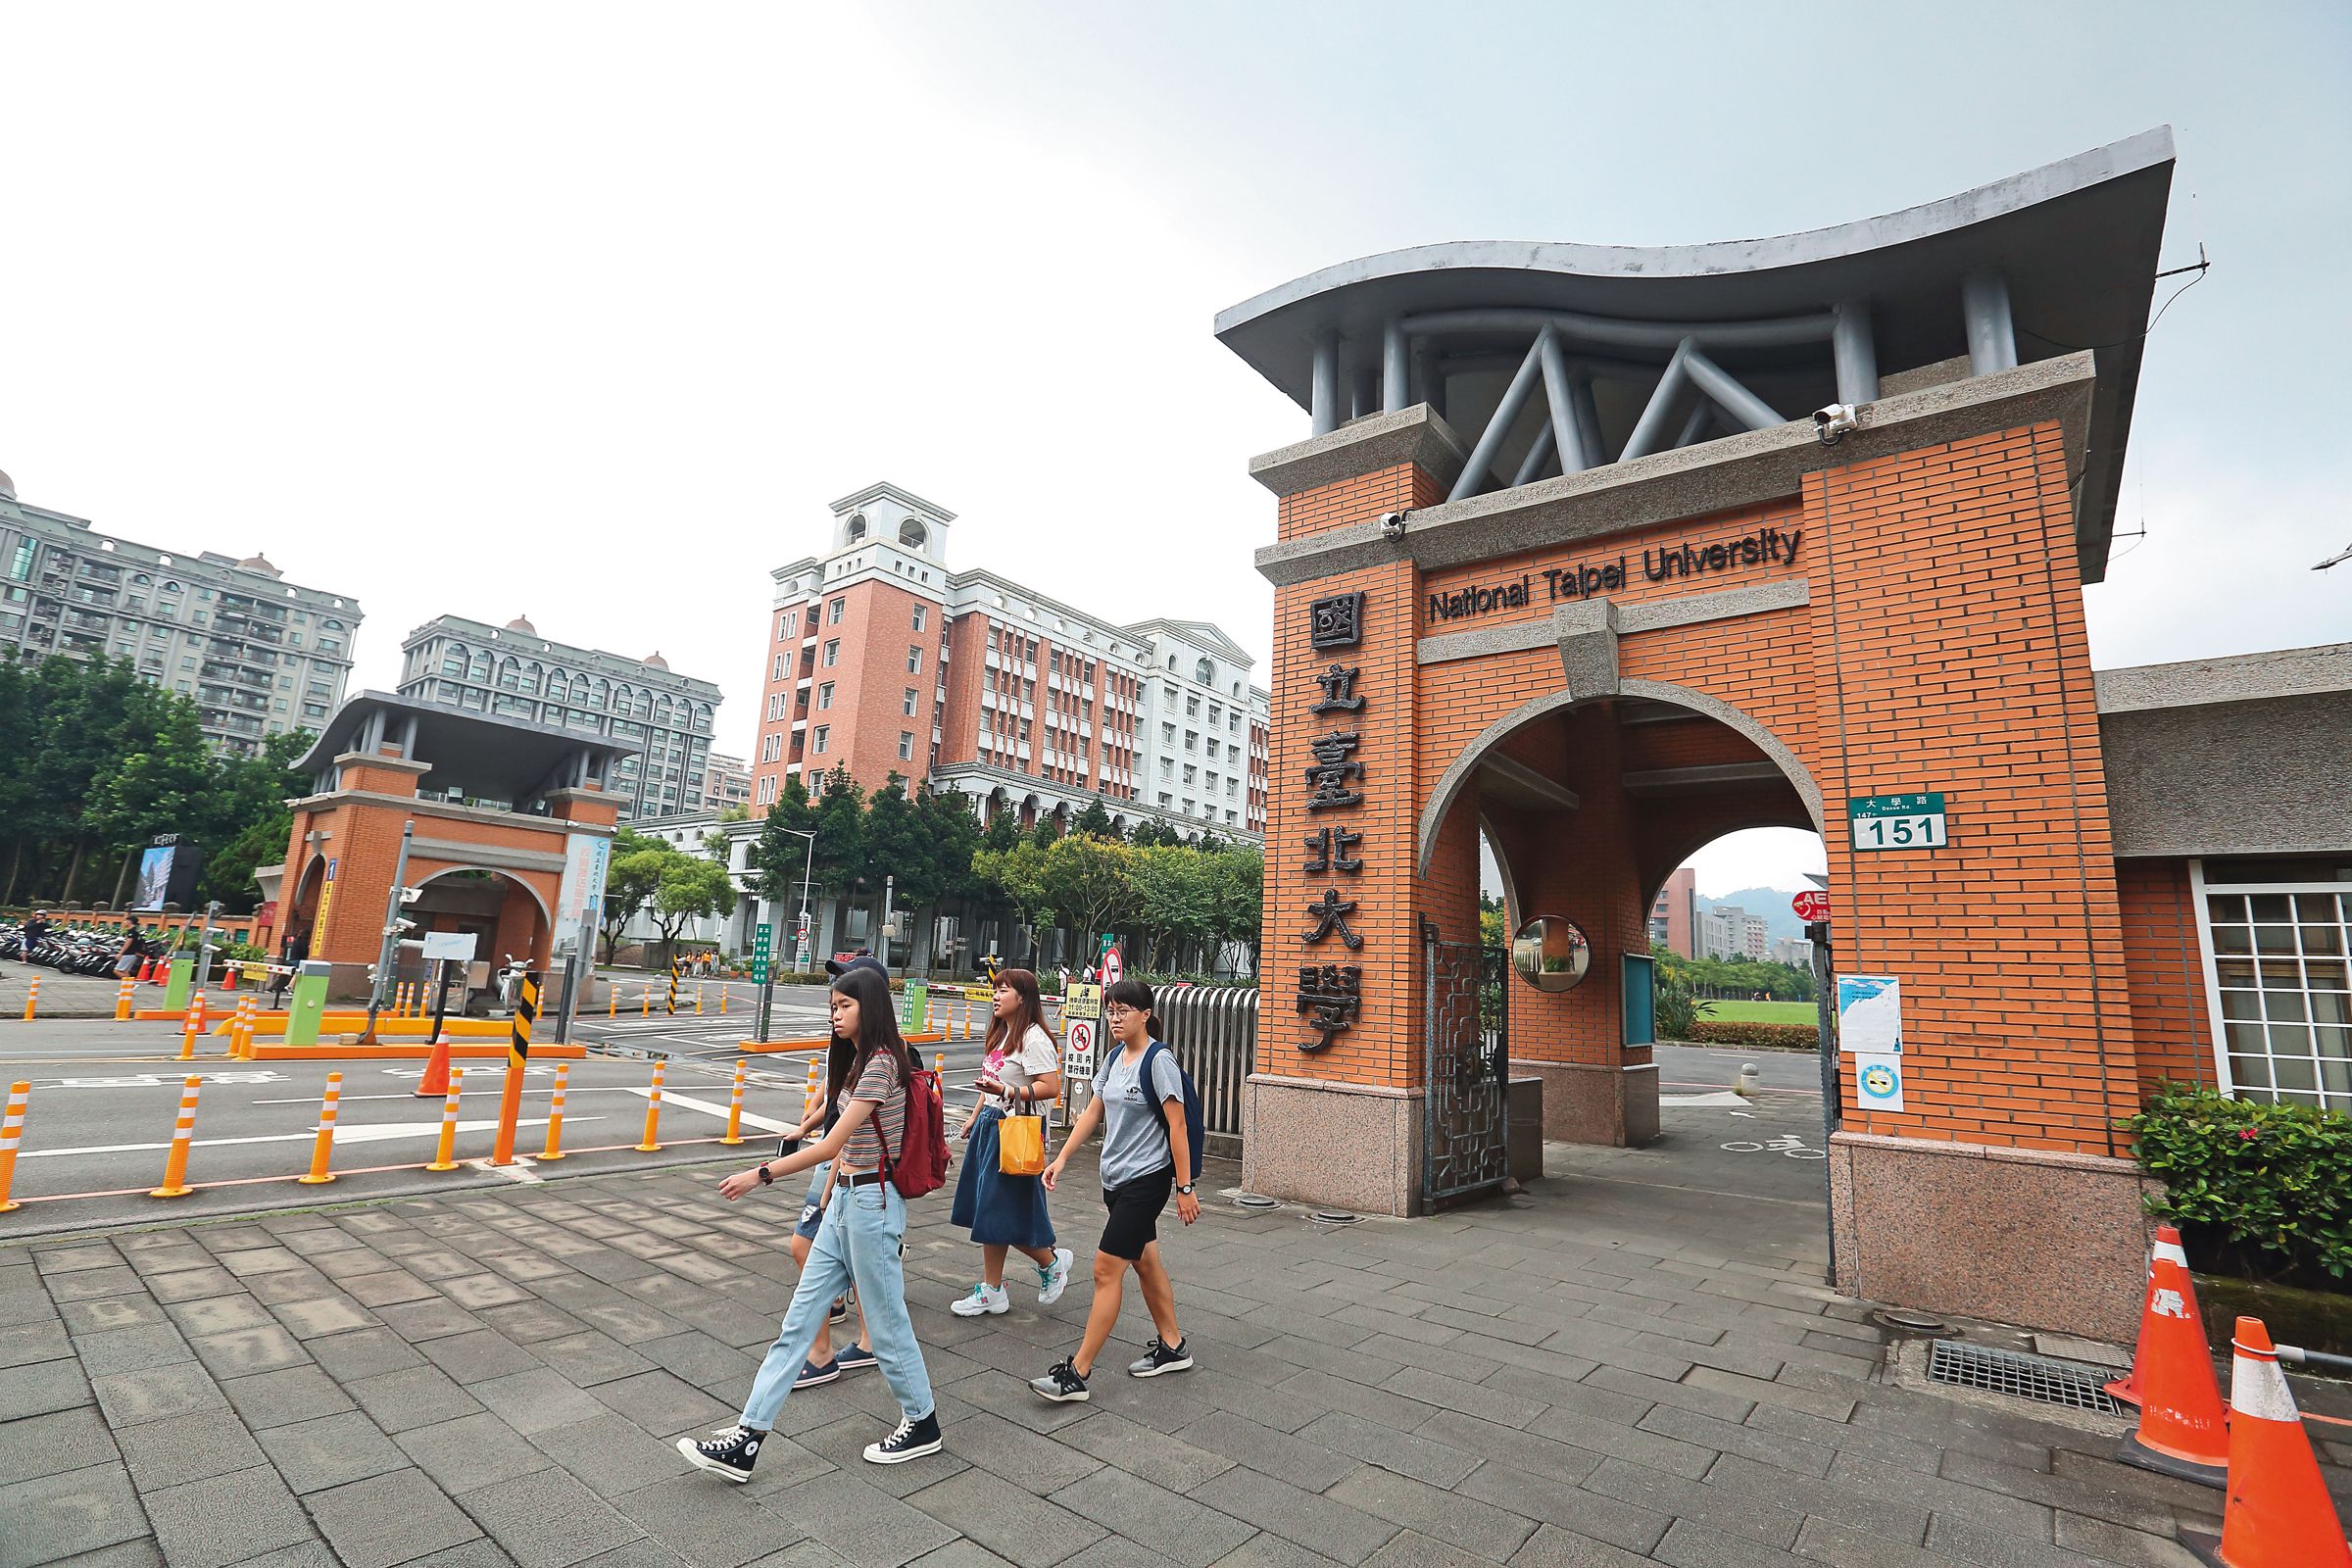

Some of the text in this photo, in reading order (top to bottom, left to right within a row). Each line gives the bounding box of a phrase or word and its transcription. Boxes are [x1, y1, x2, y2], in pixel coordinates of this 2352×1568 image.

[1430, 527, 1802, 622] National Taipei University
[1866, 796, 1927, 808] 大學路
[1296, 590, 1366, 1054] 國立臺北大學
[1869, 817, 1933, 846] 151
[1804, 893, 1830, 906] AE
[1067, 1053, 1092, 1064] 校園內
[1067, 1064, 1091, 1076] 禁行機車
